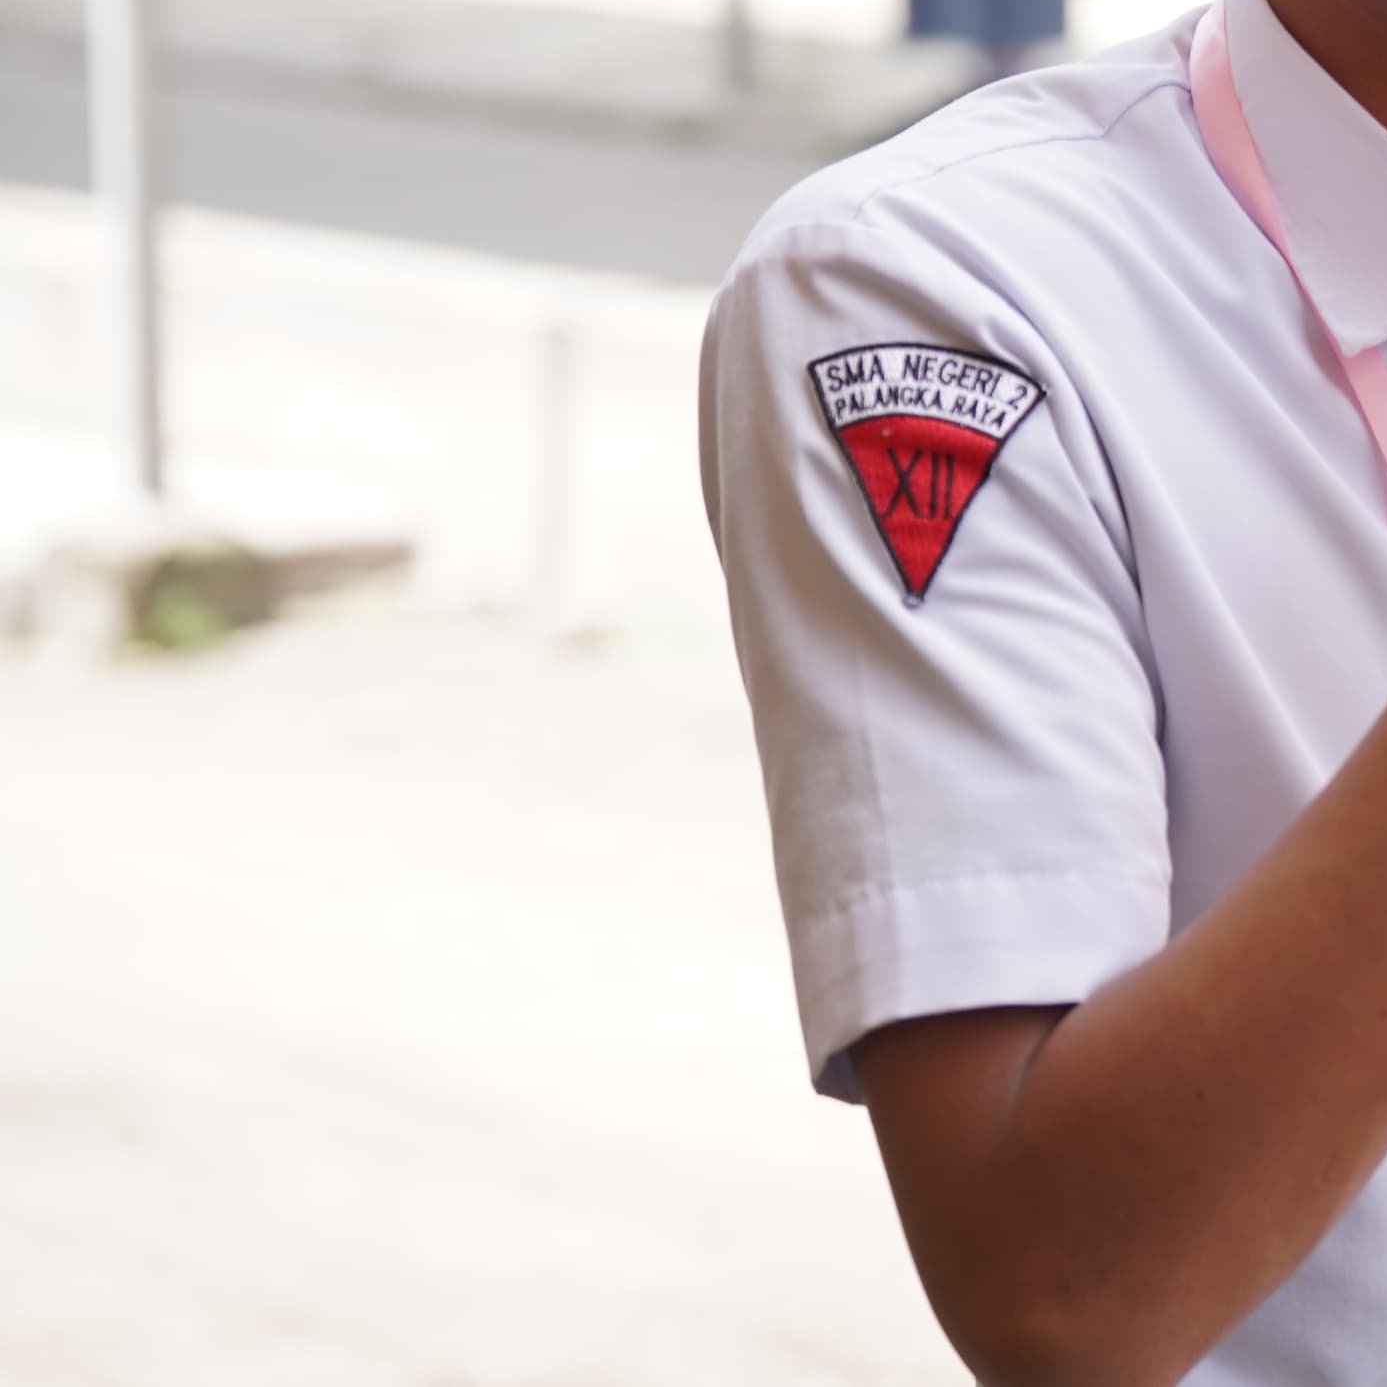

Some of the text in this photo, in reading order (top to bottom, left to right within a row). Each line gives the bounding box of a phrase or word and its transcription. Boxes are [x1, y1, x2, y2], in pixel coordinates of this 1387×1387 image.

[827, 354, 1028, 411] SMA NEGERI 2
[834, 386, 1008, 428] PALANGKA RAYA
[879, 447, 956, 519] XII
